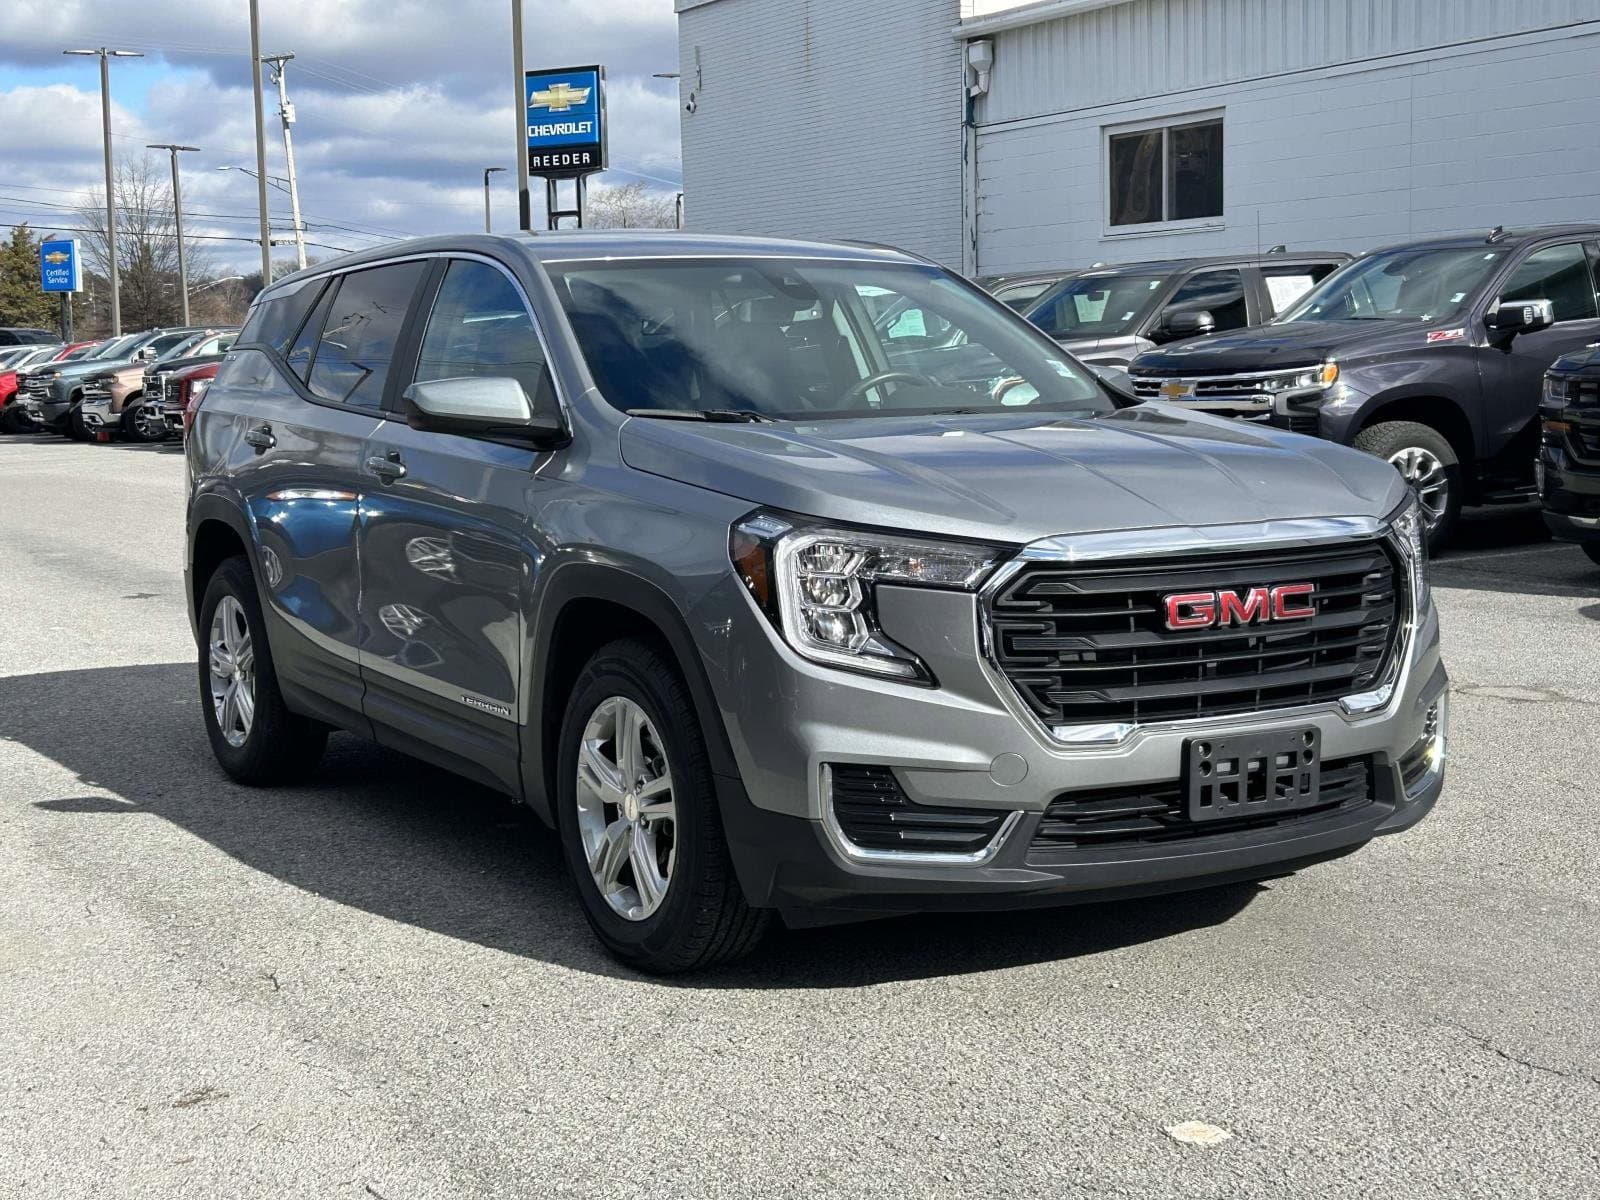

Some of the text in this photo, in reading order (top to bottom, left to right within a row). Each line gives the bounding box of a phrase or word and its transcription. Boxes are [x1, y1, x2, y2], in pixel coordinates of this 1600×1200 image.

[528, 121, 593, 137] CHEVROLET
[533, 152, 591, 167] REEDER
[46, 268, 70, 277] Certified
[47, 276, 68, 284] Service
[1164, 583, 1315, 630] GMC
[460, 694, 511, 715] TERRAIN
